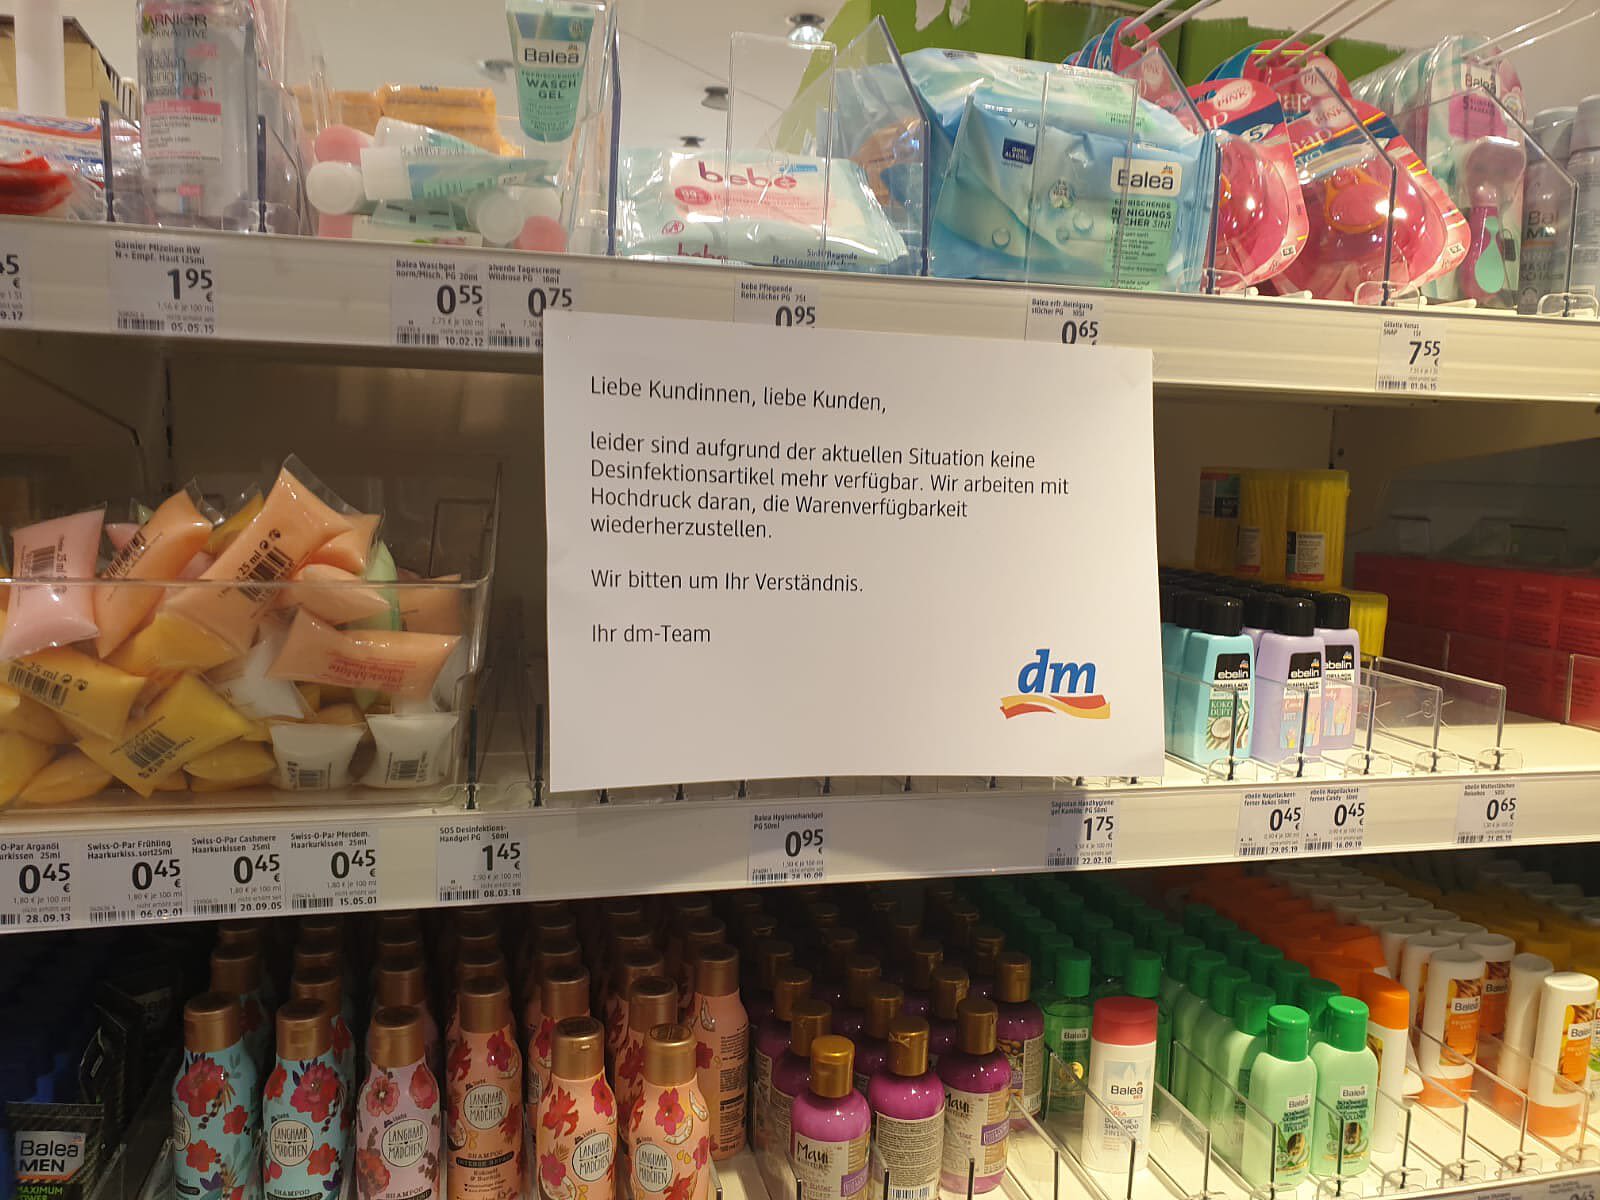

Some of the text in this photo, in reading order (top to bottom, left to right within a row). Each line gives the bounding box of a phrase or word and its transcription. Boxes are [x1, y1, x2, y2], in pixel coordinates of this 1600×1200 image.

[524, 47, 579, 64] Balea
[526, 79, 576, 89] WASCH
[538, 91, 564, 99] GEL
[1216, 86, 1249, 108] PINK
[698, 160, 797, 189] bebe
[115, 240, 146, 250] Garnier
[149, 243, 184, 254] Mizellen
[159, 253, 178, 262] Haut
[182, 255, 205, 264] 125ml
[419, 261, 455, 272] Waschgel
[488, 272, 520, 282] Wildrose
[759, 282, 793, 293] Pflegende
[206, 292, 213, 302] €
[476, 306, 483, 317] €
[171, 322, 214, 334] 05.05.15
[445, 336, 483, 347] 10.02.12
[590, 375, 887, 414] Liebe Kundinnen, liebe Kunden,
[590, 431, 1036, 469] leider sind aufgrund der aktuellen Situation keine
[591, 459, 1070, 495] Desinfektionsartikel mehr verfügbar. Wir arbeiten mit
[590, 486, 968, 520] Hochdruck daran, die Warenverfügbarkeit
[590, 514, 773, 539] wiederherzustellen.
[238, 549, 263, 576] 25 ml
[590, 569, 864, 593] Wir bitten um Ihr Verständnis.
[592, 623, 712, 644] Ihr dm-Team
[1018, 648, 1096, 694] dm
[1217, 669, 1249, 680] ebelin
[1290, 668, 1320, 679] ebelin
[440, 824, 507, 834] SOS Desinfektions-
[192, 834, 276, 846] Swiss-O-Par Cashmere
[290, 831, 334, 841] Swiss-O-Par
[440, 832, 509, 843] Handgel PG 50ml
[1107, 832, 1113, 841] €
[26, 842, 60, 852] Arganöl
[87, 839, 171, 851] Swiss-O-Par Frühling
[192, 842, 270, 854] Haarkurkissen 25ml
[291, 839, 367, 849] Haarkurkissen 25ml
[40, 851, 61, 860] 25ml
[514, 860, 521, 870] €
[274, 873, 280, 882] €
[370, 868, 376, 877] €
[63, 883, 71, 893] €
[174, 879, 182, 889] €
[484, 888, 521, 898] 08.03.18
[240, 901, 282, 912] 20.09.05
[340, 896, 377, 907] 15.05.01
[26, 913, 71, 924] 28.09.13
[1110, 1084, 1144, 1096] Balea
[469, 1091, 503, 1105] LANGHAAR
[274, 1126, 308, 1140] LANGHAAR
[388, 1124, 424, 1140] LANGHAAR
[20, 1140, 79, 1158] Balea
[797, 1139, 829, 1164] Maui
[20, 1159, 65, 1172] MEN
[16, 1185, 64, 1196] MAXIMUM
